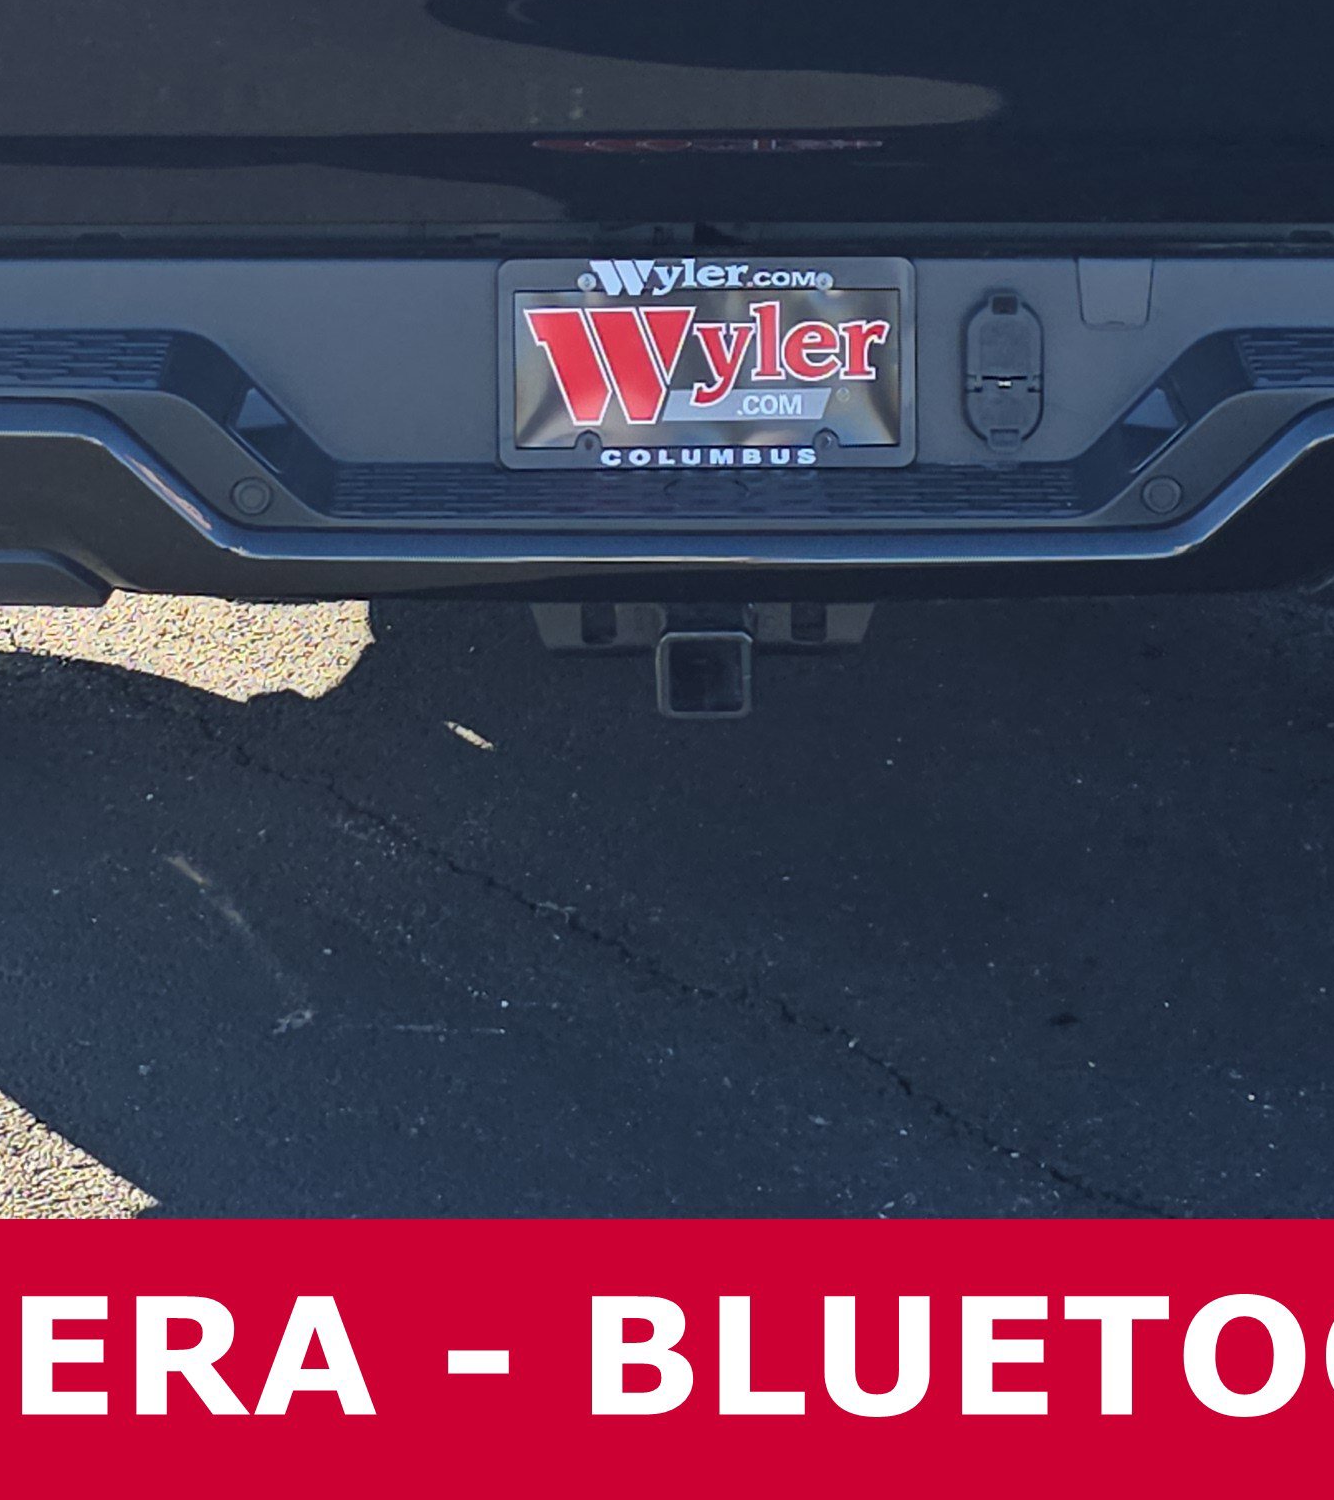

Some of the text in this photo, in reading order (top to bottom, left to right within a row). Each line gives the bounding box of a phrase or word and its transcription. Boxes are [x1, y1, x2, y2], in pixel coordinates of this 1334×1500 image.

[523, 301, 890, 426] Wyler
[737, 394, 802, 416] .COM
[600, 449, 817, 466] COLUMBUS
